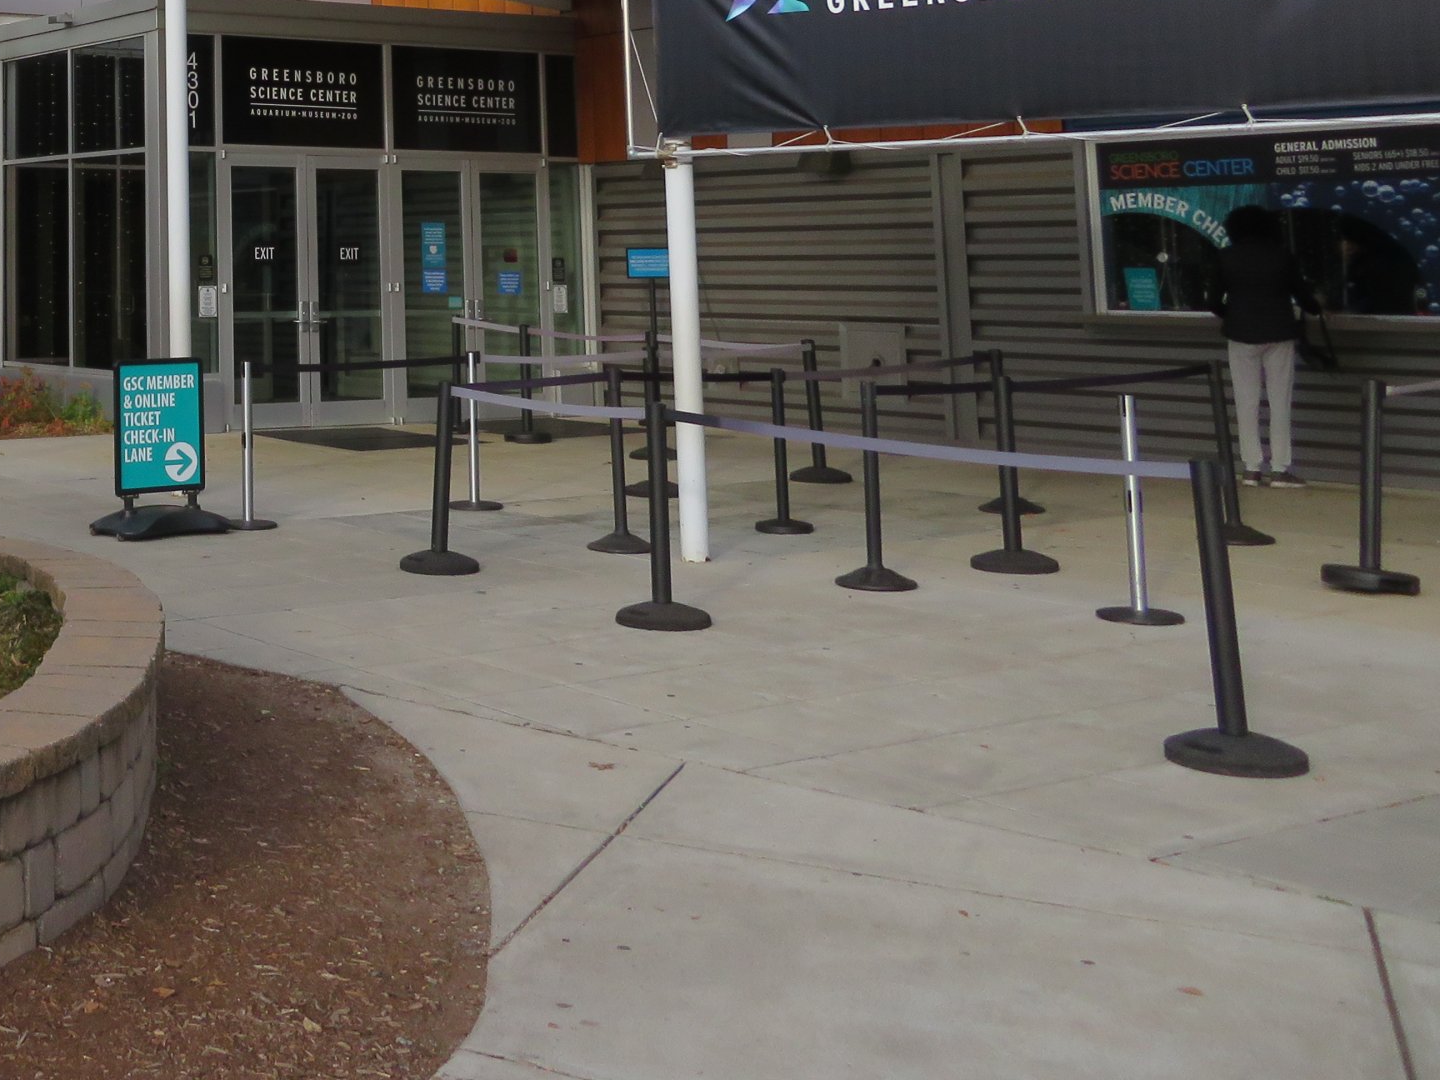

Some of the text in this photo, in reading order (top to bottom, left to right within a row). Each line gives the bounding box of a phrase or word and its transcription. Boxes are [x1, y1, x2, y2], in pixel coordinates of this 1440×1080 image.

[249, 67, 357, 85] GREENSBORO
[416, 75, 515, 92] GREENSBORO
[187, 51, 199, 129] 4301
[250, 86, 357, 104] SCIENCE CENTER
[417, 94, 515, 109] SCIENCE CENTER
[1274, 137, 1377, 153] GENERAL ADMISSION
[1275, 156, 1296, 165] ADULT
[1352, 151, 1383, 161] SENIORS
[1110, 157, 1254, 180] SCIENCE CENTER
[1276, 167, 1296, 176] CHILD
[1353, 162, 1371, 172] KIDS
[1378, 161, 1394, 171] AND
[1394, 160, 1420, 170] UNDER
[1421, 159, 1440, 169] FREE
[1109, 192, 1190, 218] MEMBER
[254, 246, 275, 260] EXIT
[339, 247, 360, 261] EXIT
[123, 374, 195, 391] GSC MEMBER
[123, 392, 176, 409] & ONLINE
[124, 411, 161, 427] TICKET
[124, 428, 176, 445] CHECK-IN
[124, 447, 153, 463] LANE
